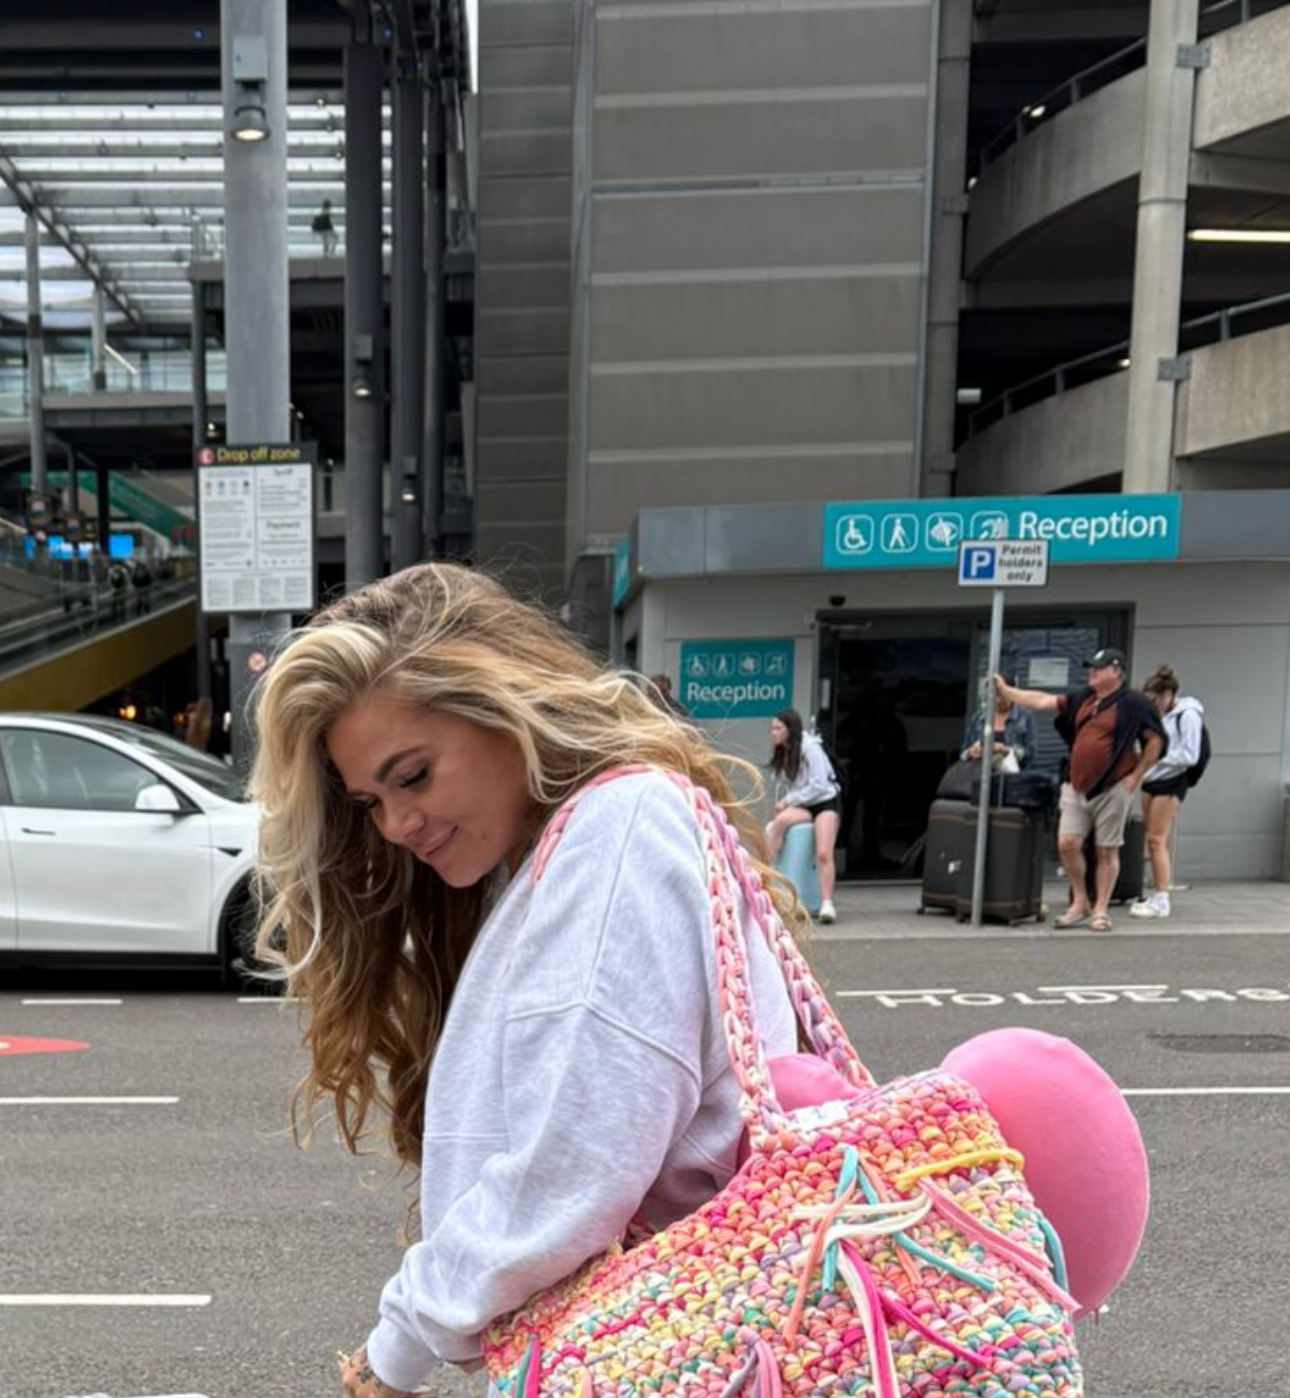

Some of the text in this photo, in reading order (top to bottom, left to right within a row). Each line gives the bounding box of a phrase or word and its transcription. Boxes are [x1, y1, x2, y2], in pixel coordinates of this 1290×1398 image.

[217, 447, 248, 462] Drop
[251, 446, 268, 460] off
[269, 448, 299, 460] zone
[267, 521, 300, 530] Payment
[1019, 509, 1168, 546] Reception
[1002, 543, 1042, 555] Permit
[970, 550, 991, 577] P
[999, 558, 1043, 568] holders
[1007, 570, 1033, 583] only
[687, 680, 786, 706] Reception
